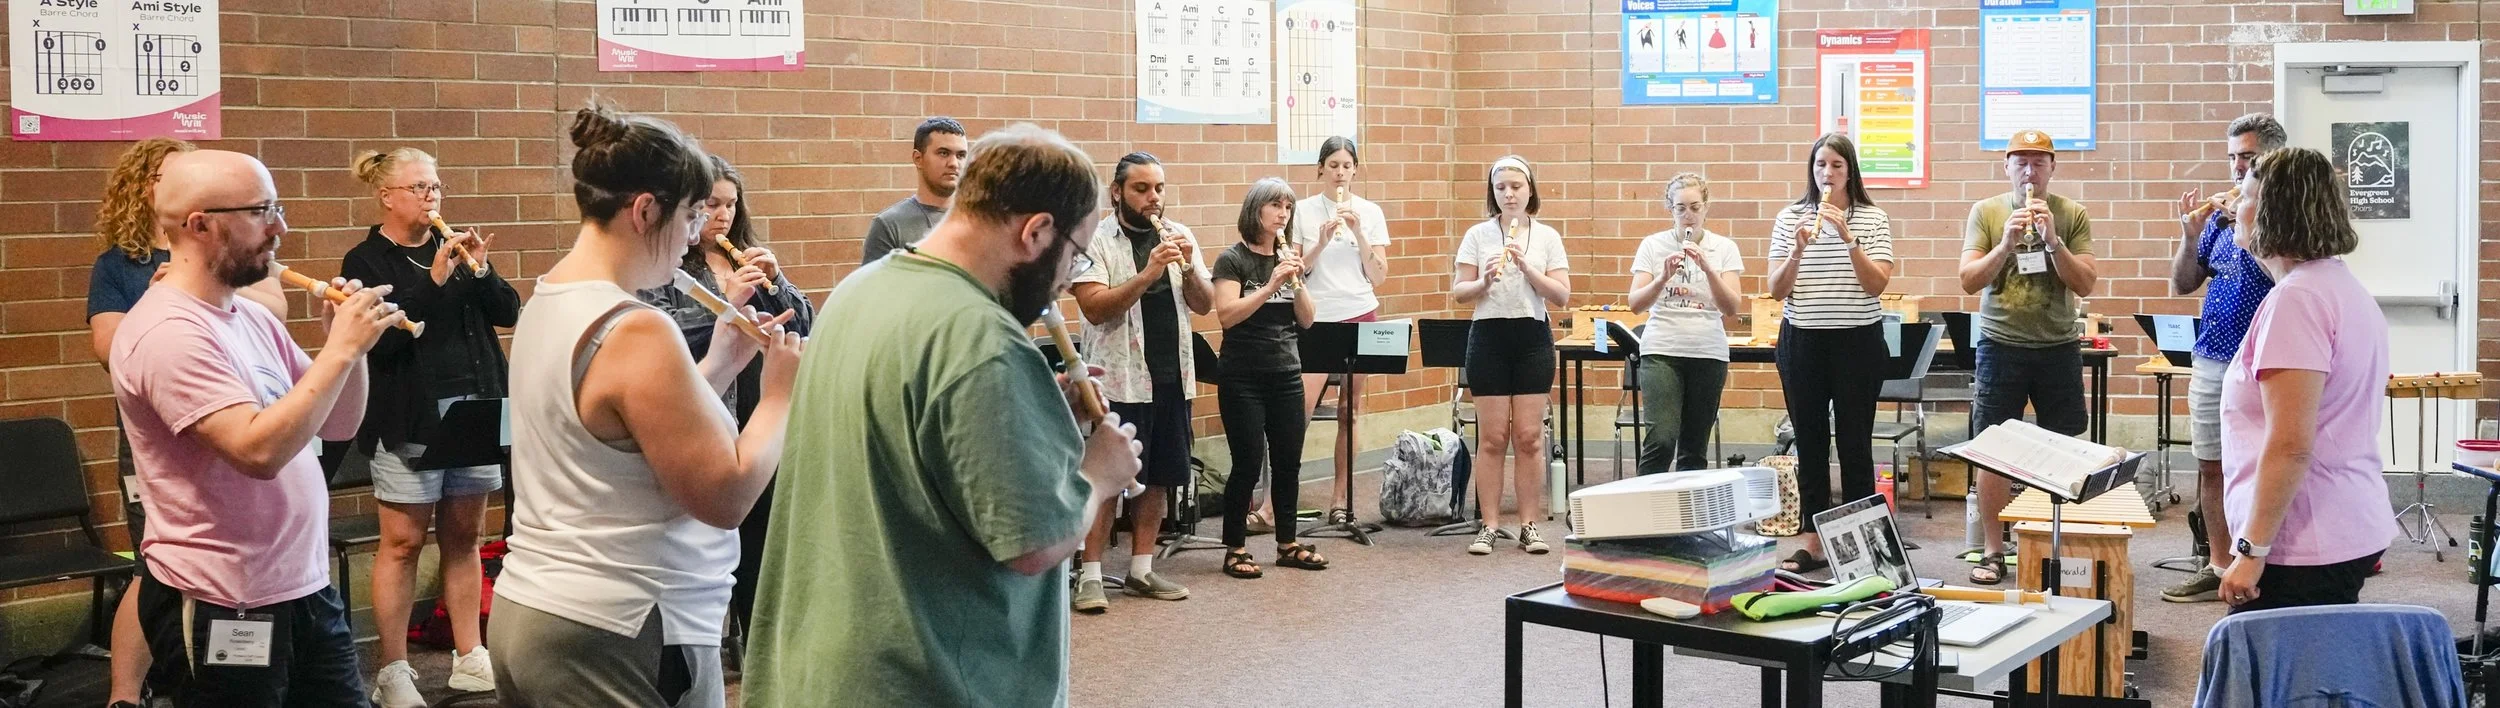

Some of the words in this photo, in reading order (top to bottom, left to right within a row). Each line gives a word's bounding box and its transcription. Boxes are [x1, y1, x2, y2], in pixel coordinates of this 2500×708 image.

[56, 0, 98, 10] Style
[132, 1, 159, 11] Ami
[163, 2, 202, 15] Style
[1154, 2, 1162, 10] A
[1182, 4, 1199, 13] Ami
[40, 9, 67, 17] Barre
[69, 10, 99, 18] Chord
[1218, 6, 1225, 14] C
[1247, 7, 1254, 16] D
[167, 14, 194, 22] Chord
[1820, 34, 1863, 47] Dynamics
[611, 48, 639, 56] Music
[1150, 54, 1167, 63] Dmi
[1187, 55, 1194, 64] E
[1214, 57, 1230, 66] Emi
[1248, 58, 1255, 66] G
[172, 111, 207, 120] Music
[182, 119, 202, 127] Will
[2350, 197, 2368, 205] High
[2060, 566, 2087, 576] merald
[231, 628, 254, 637] Sean
